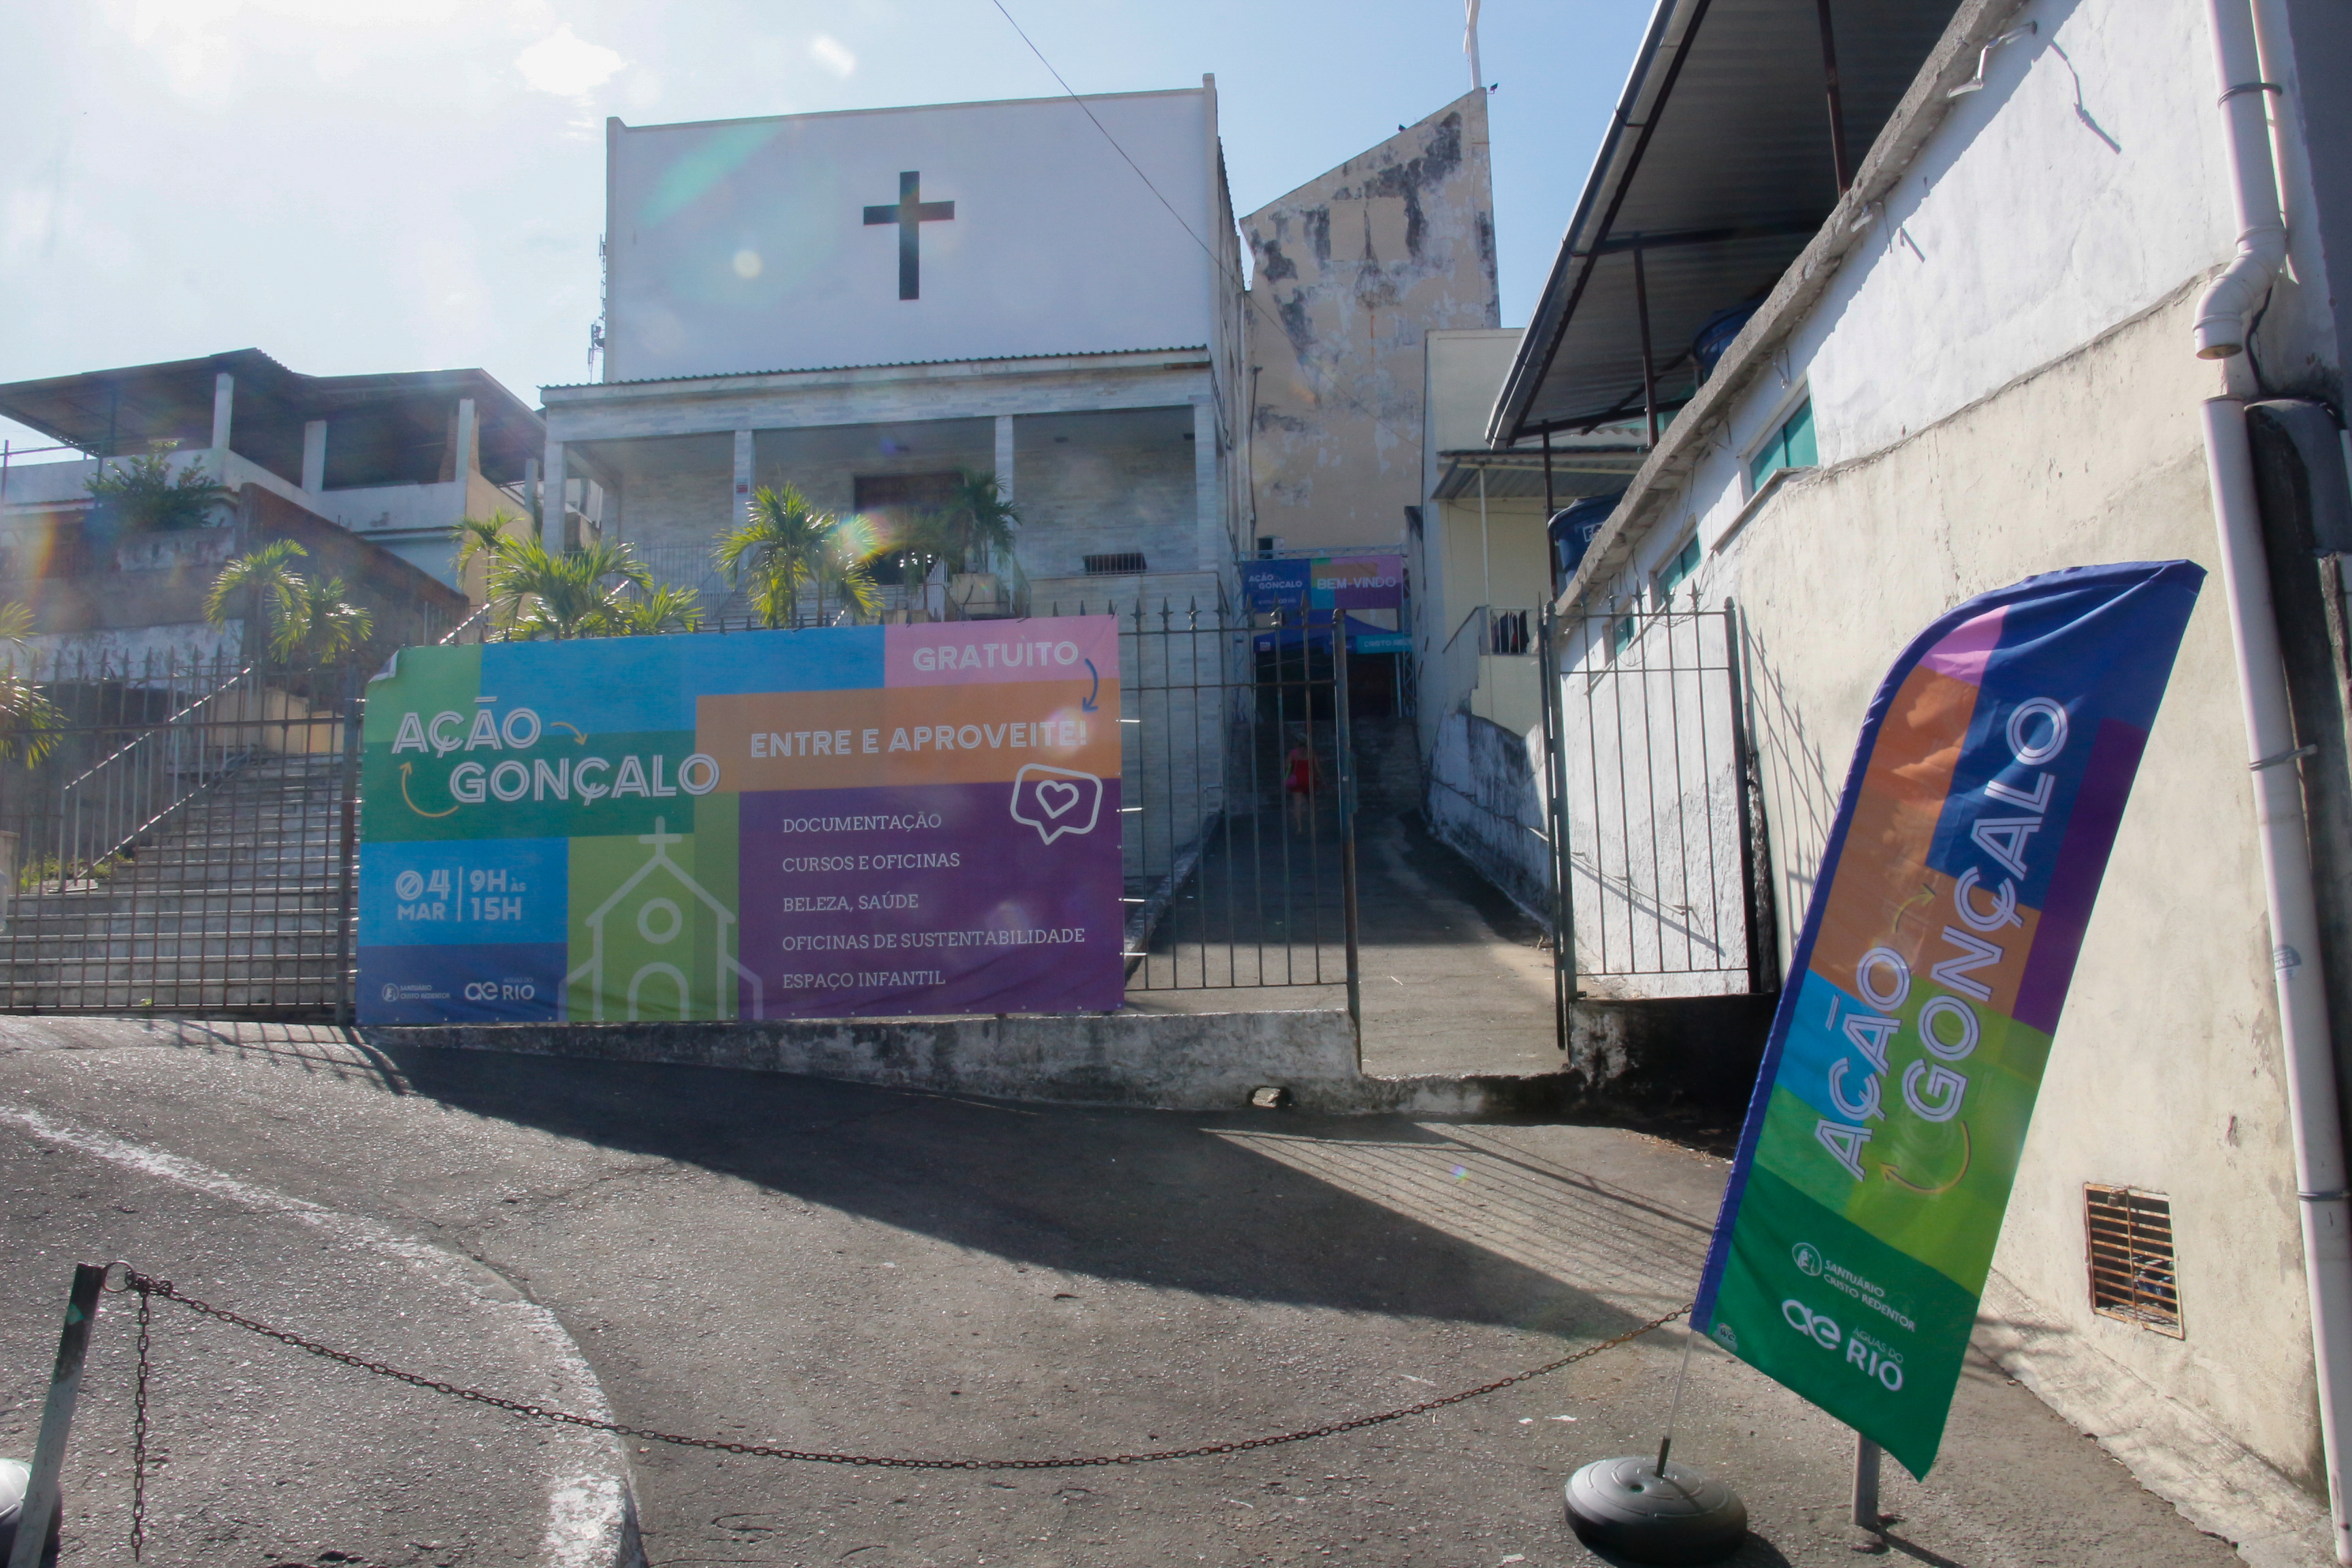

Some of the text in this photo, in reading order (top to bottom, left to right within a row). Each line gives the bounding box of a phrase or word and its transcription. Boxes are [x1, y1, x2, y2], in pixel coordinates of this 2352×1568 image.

[391, 696, 542, 758] AÇÃO
[750, 720, 1087, 757] ENTRE E APROVEITE!
[449, 753, 721, 806] GONÇALO
[783, 811, 942, 833] DOCUMENTAÇÃO
[470, 869, 506, 892] 9H
[783, 852, 960, 872] CURSOS E OFICINAS
[397, 896, 522, 920] MAR 15H
[783, 891, 919, 912] BELEZA, SAÚDE
[1901, 697, 2069, 1123] GONÇALO
[783, 928, 1085, 951] OFICINAS DE SUSTENTABILIDADE
[502, 985, 535, 1000] RIO
[783, 970, 946, 991] ESPAÇO INFANTIL
[1814, 945, 1912, 1183] AÇÃO
[1825, 1260, 1886, 1298] SANTUÁRIO
[1823, 1273, 1916, 1333] CRISTO REDENTOR
[1852, 1325, 1904, 1363] ÁGUAS DO
[1846, 1337, 1904, 1392] RIO
